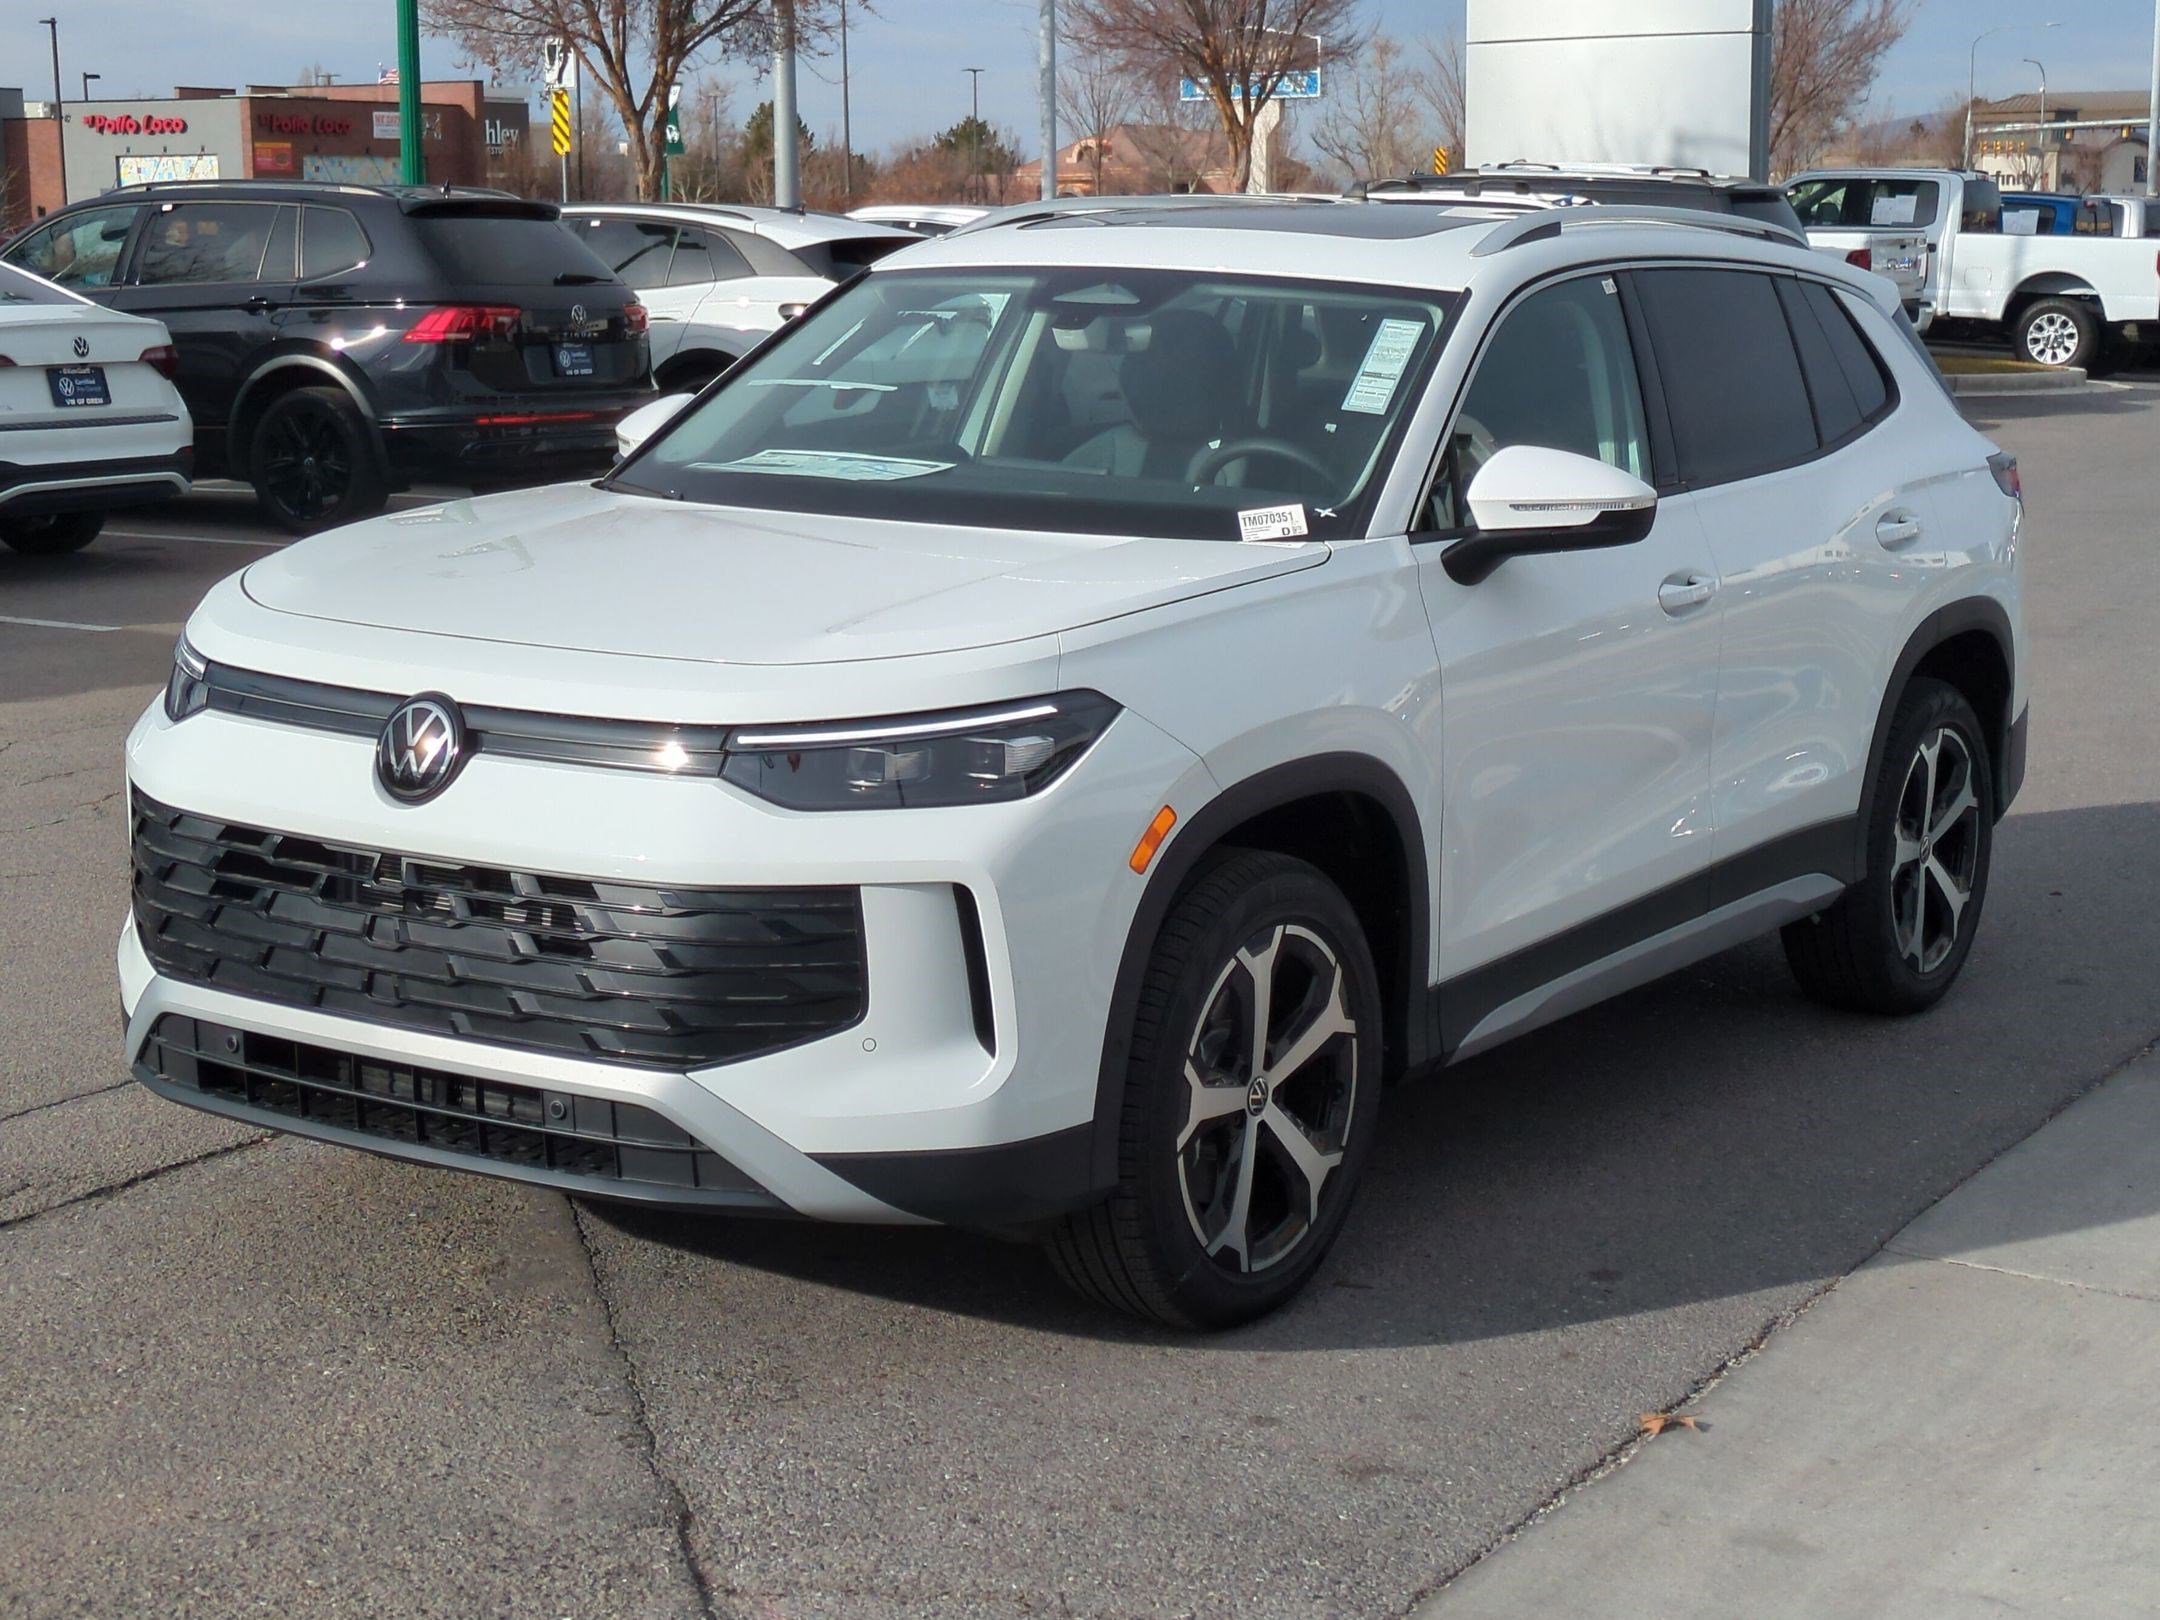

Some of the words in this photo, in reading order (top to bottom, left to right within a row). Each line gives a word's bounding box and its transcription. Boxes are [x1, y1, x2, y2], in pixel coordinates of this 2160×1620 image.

[95, 114, 140, 134] Pollo
[142, 114, 188, 134] Loco
[271, 115, 312, 133] Pollo
[313, 114, 353, 135] Loco
[1241, 511, 1294, 527] TM070351
[1281, 526, 1291, 536] D
